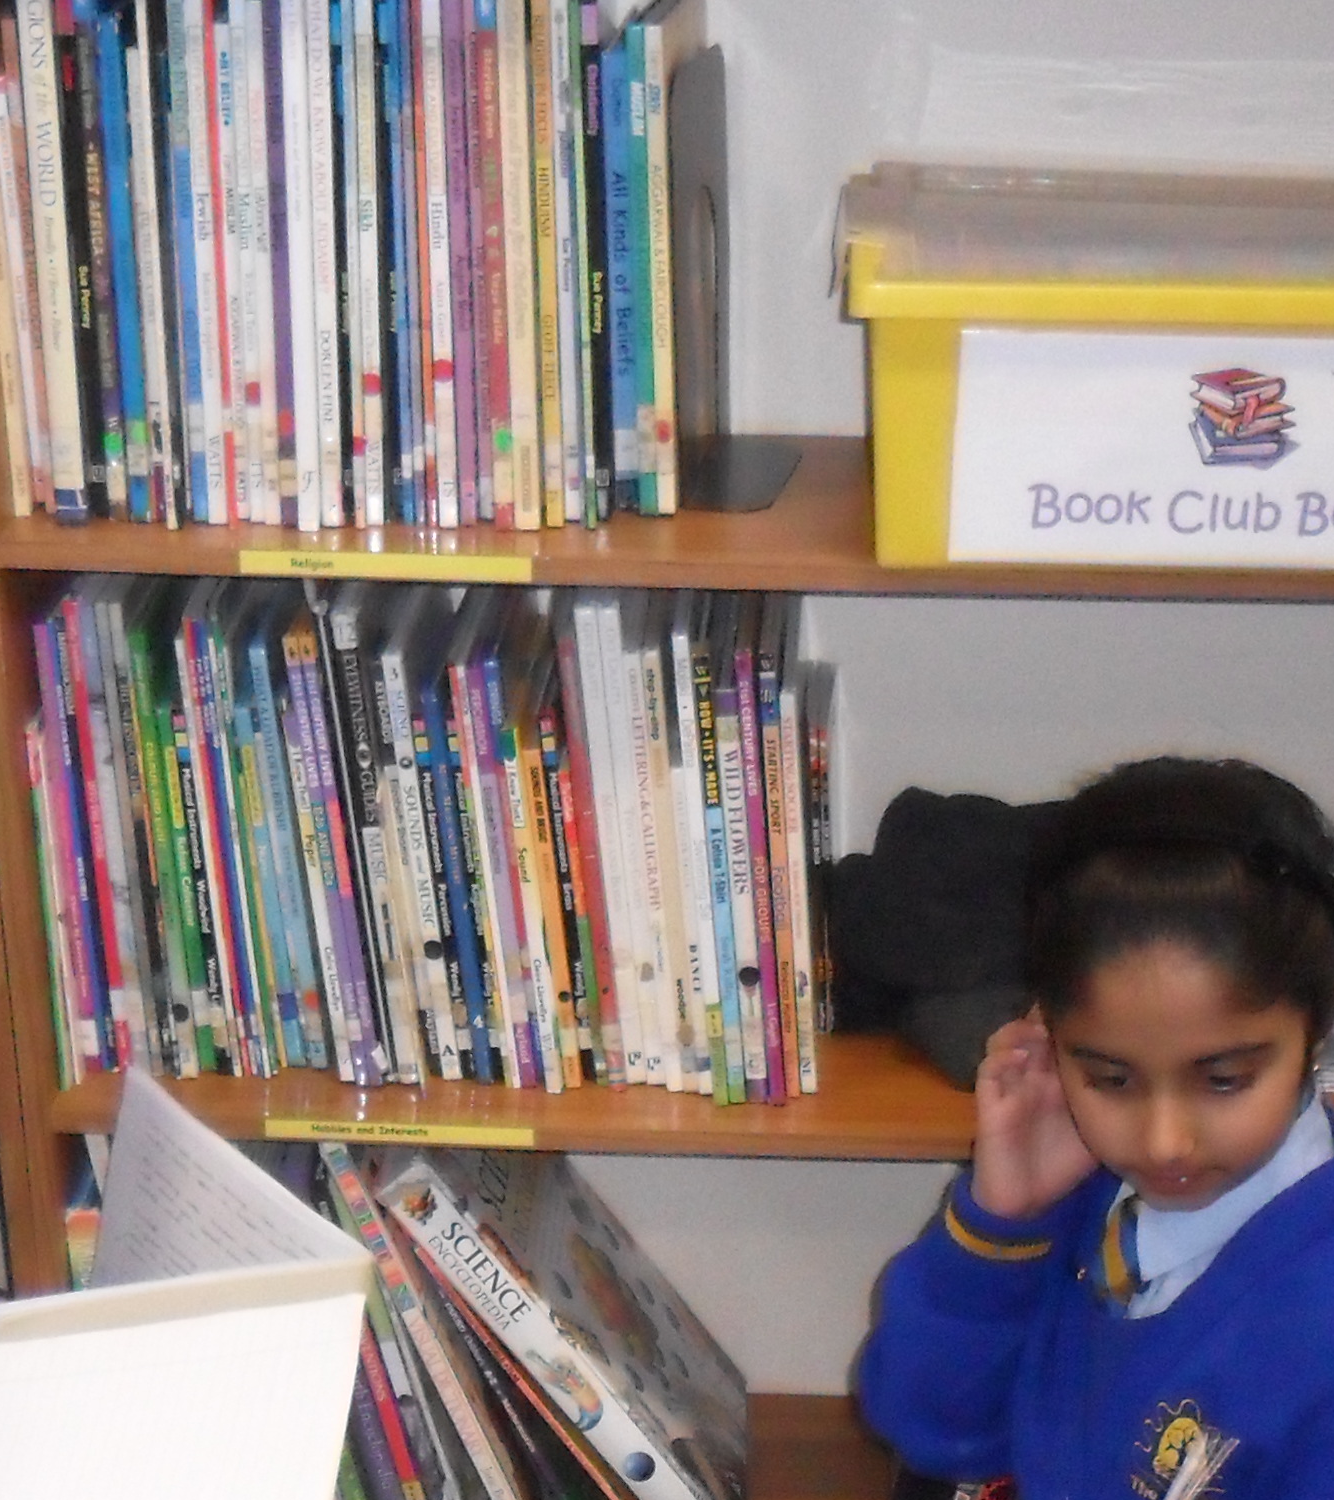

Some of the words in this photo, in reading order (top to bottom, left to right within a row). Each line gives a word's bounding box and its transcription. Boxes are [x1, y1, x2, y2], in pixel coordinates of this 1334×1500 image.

[35, 120, 57, 208] WORLD
[611, 171, 628, 199] All
[429, 202, 445, 251] Hindu
[614, 209, 629, 264] Kinds
[615, 274, 629, 296] of
[615, 307, 631, 378] Beliefs
[1028, 483, 1152, 529] Book
[1167, 490, 1283, 534] Club
[343, 654, 366, 742] EYEWITNESS
[360, 770, 375, 823] GUIDES
[697, 700, 712, 730] HOW
[705, 771, 719, 806] MADE
[723, 749, 743, 802] WILD
[368, 832, 387, 887] MUSIC
[729, 807, 749, 895] FLOWERS
[515, 1026, 530, 1064] ayland
[428, 1236, 511, 1331] ENCYCLOPEDIA
[441, 1221, 532, 1323] SCIENCE
